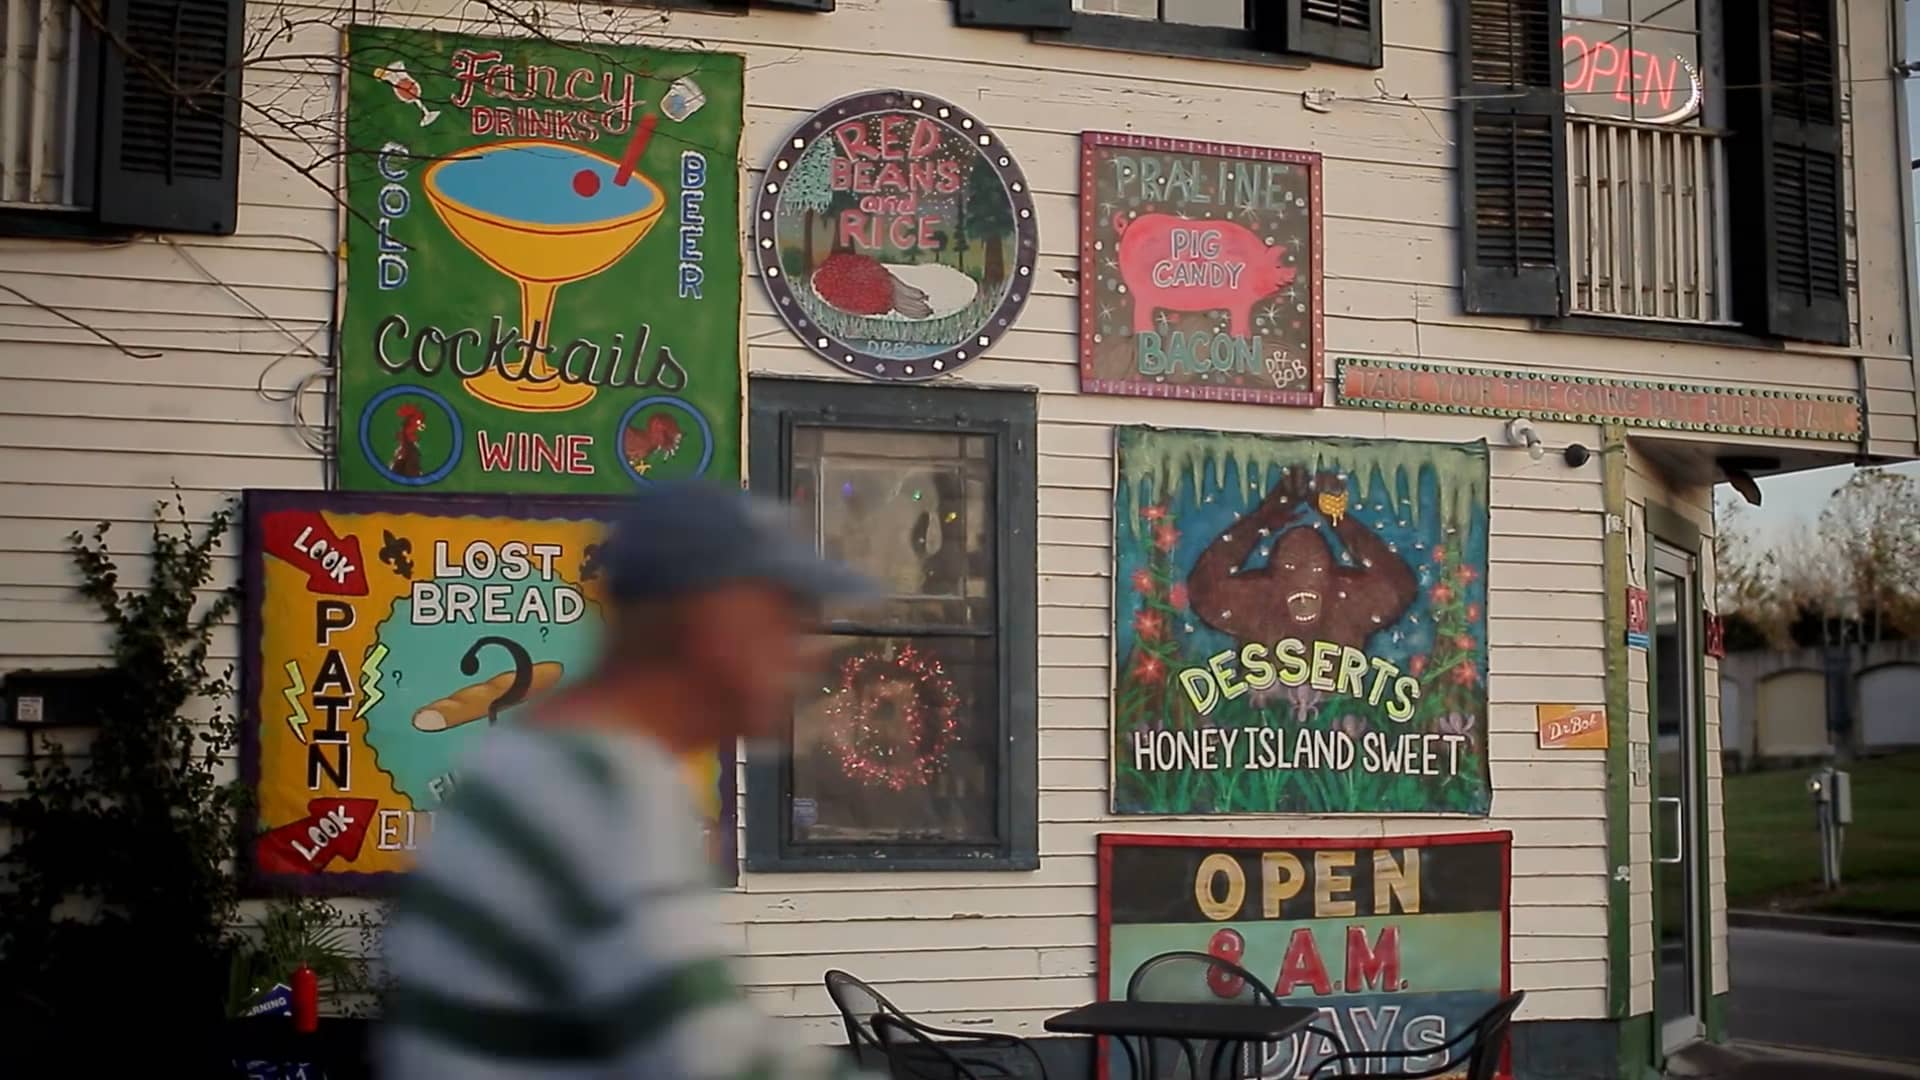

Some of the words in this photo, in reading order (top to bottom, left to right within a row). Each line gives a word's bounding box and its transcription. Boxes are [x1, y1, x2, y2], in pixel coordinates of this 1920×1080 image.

[451, 48, 646, 134] Fancy
[1562, 35, 1679, 110] OPEN
[471, 107, 599, 142] DRINKS
[835, 115, 943, 163] RED
[831, 157, 961, 193] BEANS
[1114, 156, 1289, 209] PRALINE
[377, 141, 411, 290] COLD
[678, 150, 707, 299] BEER
[839, 208, 941, 249] RICE
[860, 193, 917, 215] and
[1171, 229, 1221, 260] PIG
[1152, 261, 1245, 289] CANDY
[374, 314, 688, 391] Cocktails
[1137, 331, 1263, 375] BACON
[1359, 370, 1421, 400] TAKE
[1433, 374, 1494, 405] YOUR
[1502, 380, 1557, 410] TIME
[1564, 384, 1642, 415] GOING
[1704, 396, 1784, 428] HURRY
[477, 431, 594, 474] WINE
[293, 526, 354, 584] LOOK
[434, 541, 564, 581] LOST
[411, 582, 585, 625] BREAD
[307, 601, 356, 791] PAIN
[1179, 638, 1421, 723] DESSERTS
[1133, 728, 1239, 771] HONEY
[1244, 727, 1354, 771] ISLAND
[1362, 732, 1466, 776] SWEET
[291, 806, 354, 861] LOOK
[1195, 848, 1421, 921] OPEN
[1206, 928, 1245, 998] 8
[1275, 926, 1409, 997] A.M.
